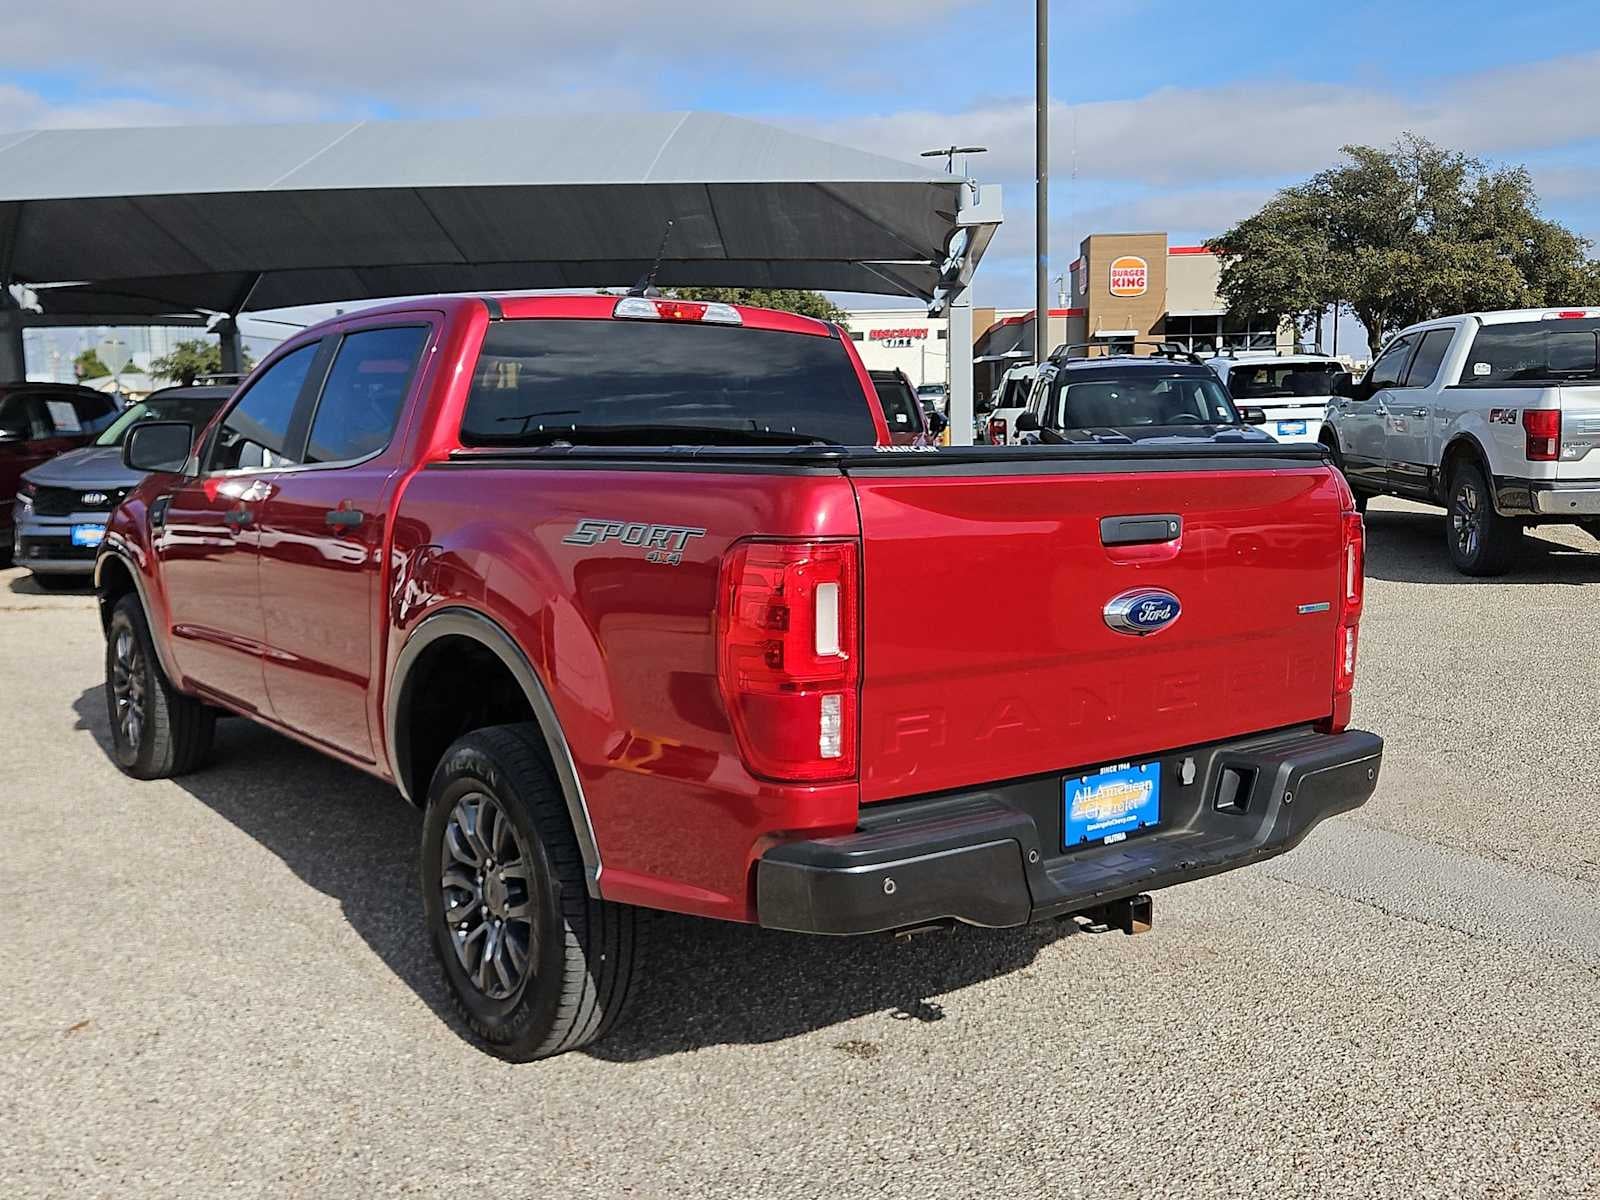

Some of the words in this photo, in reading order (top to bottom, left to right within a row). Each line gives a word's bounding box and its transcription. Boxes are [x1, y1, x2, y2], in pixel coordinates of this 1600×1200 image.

[1112, 278, 1145, 287] KING
[885, 339, 912, 348] TIRE
[1489, 408, 1518, 424] FX4
[561, 518, 707, 551] SPORT
[1138, 600, 1172, 623] Ford
[884, 653, 1318, 755] RANGER
[1100, 765, 1118, 775] SINCE
[1072, 786, 1093, 806] All
[1094, 779, 1153, 800] American
